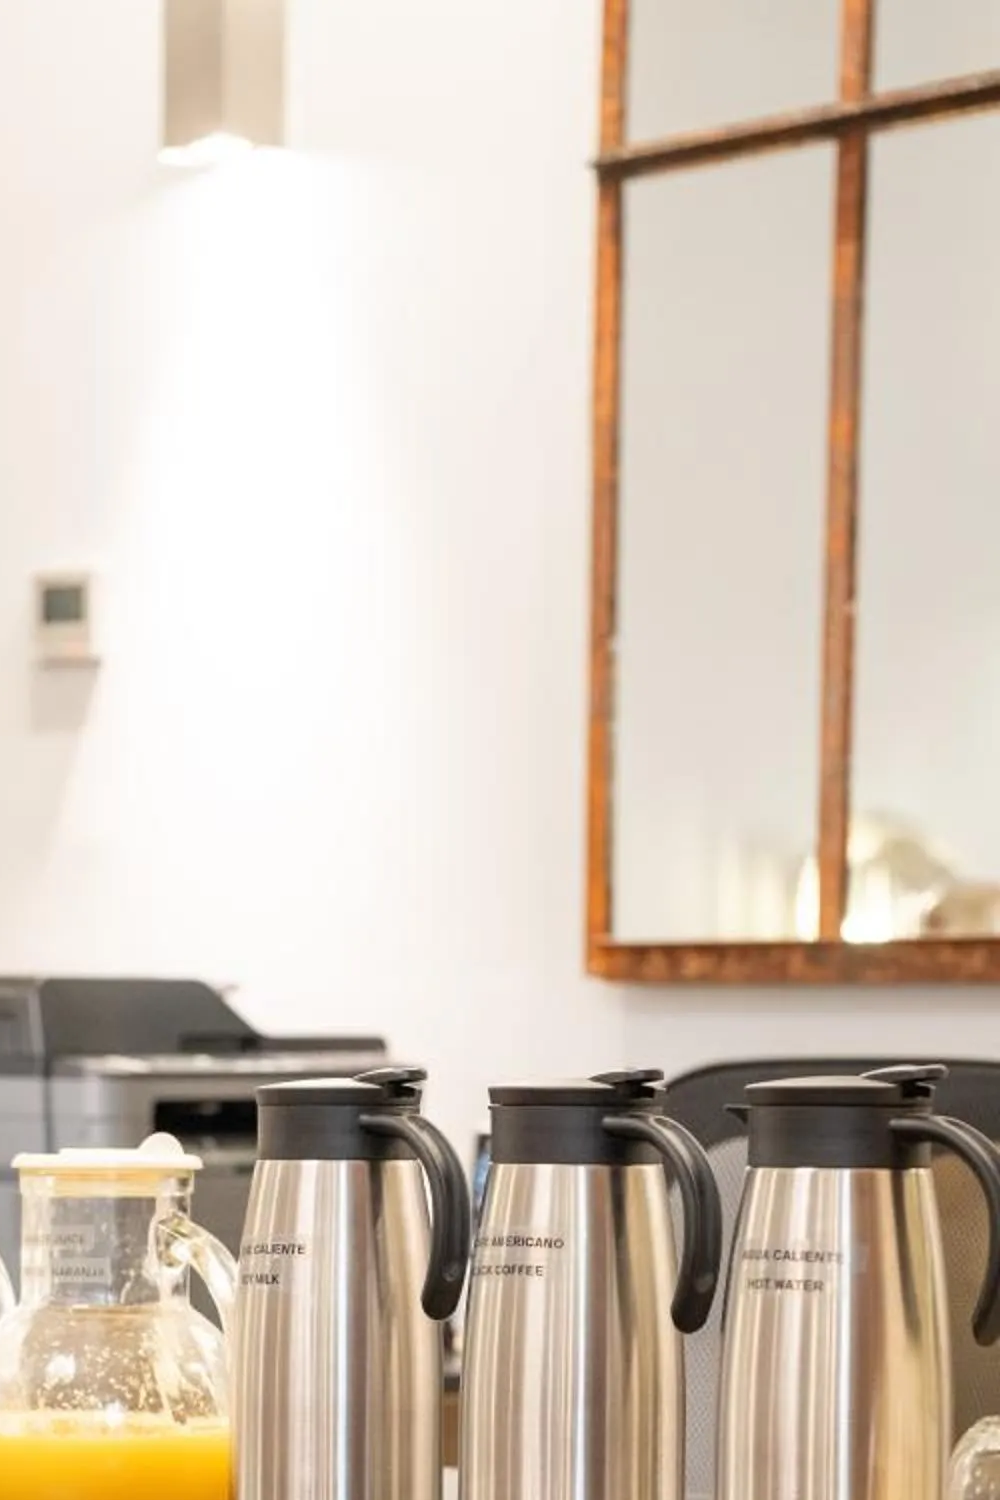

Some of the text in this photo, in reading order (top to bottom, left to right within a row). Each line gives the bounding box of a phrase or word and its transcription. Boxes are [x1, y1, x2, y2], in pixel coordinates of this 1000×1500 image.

[491, 1235, 565, 1249] AMERICANO
[253, 1243, 305, 1255] CALIENTE
[773, 1249, 844, 1264] CALIENTE
[495, 1264, 544, 1277] COFFEE
[255, 1273, 280, 1285] MILK
[746, 1279, 824, 1292] HOT WATER
